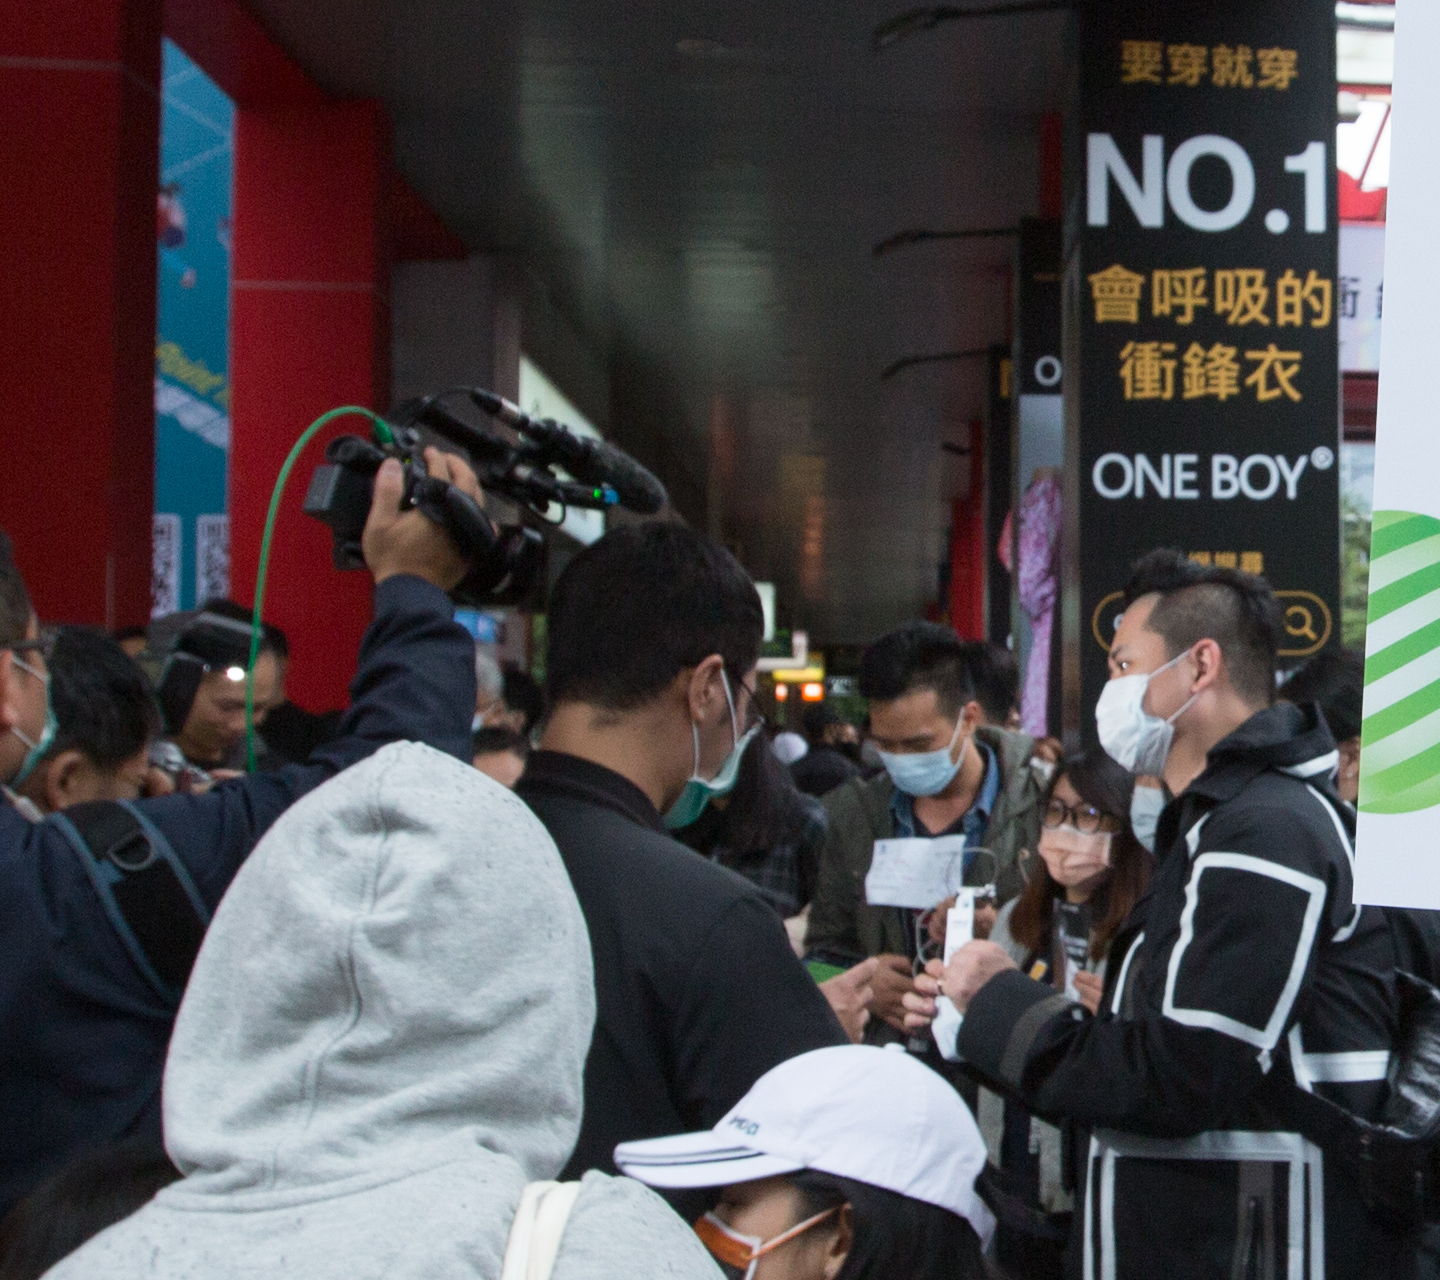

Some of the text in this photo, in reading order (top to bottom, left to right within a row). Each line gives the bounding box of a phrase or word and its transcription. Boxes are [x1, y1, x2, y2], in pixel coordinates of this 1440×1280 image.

[1119, 39, 1300, 91] 要穿就穿
[1085, 131, 1328, 235] NO.1
[1087, 263, 1333, 329] 會呼吸的
[1118, 340, 1304, 403] 衝鋒衣
[1092, 452, 1200, 500] ONE
